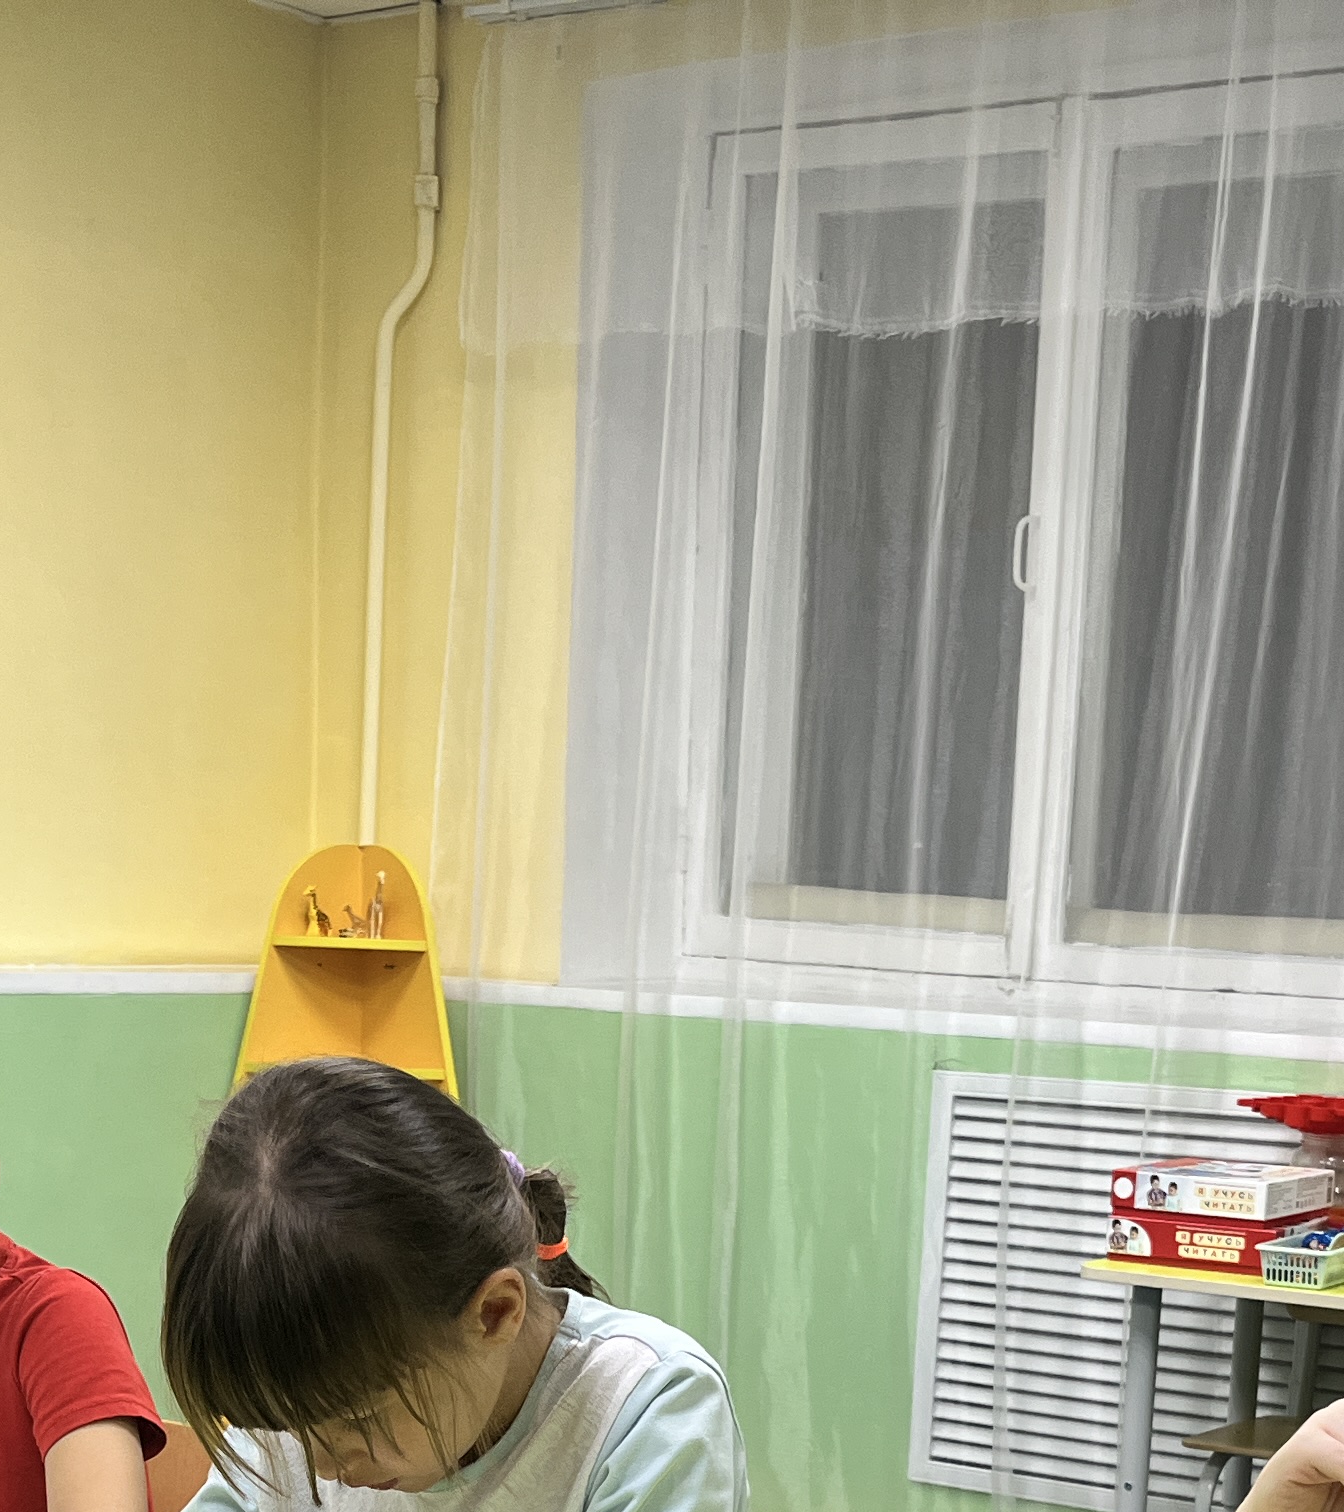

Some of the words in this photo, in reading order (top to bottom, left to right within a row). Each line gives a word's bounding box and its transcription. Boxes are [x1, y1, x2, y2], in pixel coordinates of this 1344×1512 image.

[1196, 1187, 1205, 1196] Я
[1212, 1188, 1255, 1200] УЧУСЬ
[1203, 1200, 1255, 1213] ЧИТАТЬ
[1179, 1233, 1187, 1241] Я
[1197, 1235, 1243, 1247] УЧУСЬ
[1182, 1247, 1237, 1260] ЧИТАТЬ
